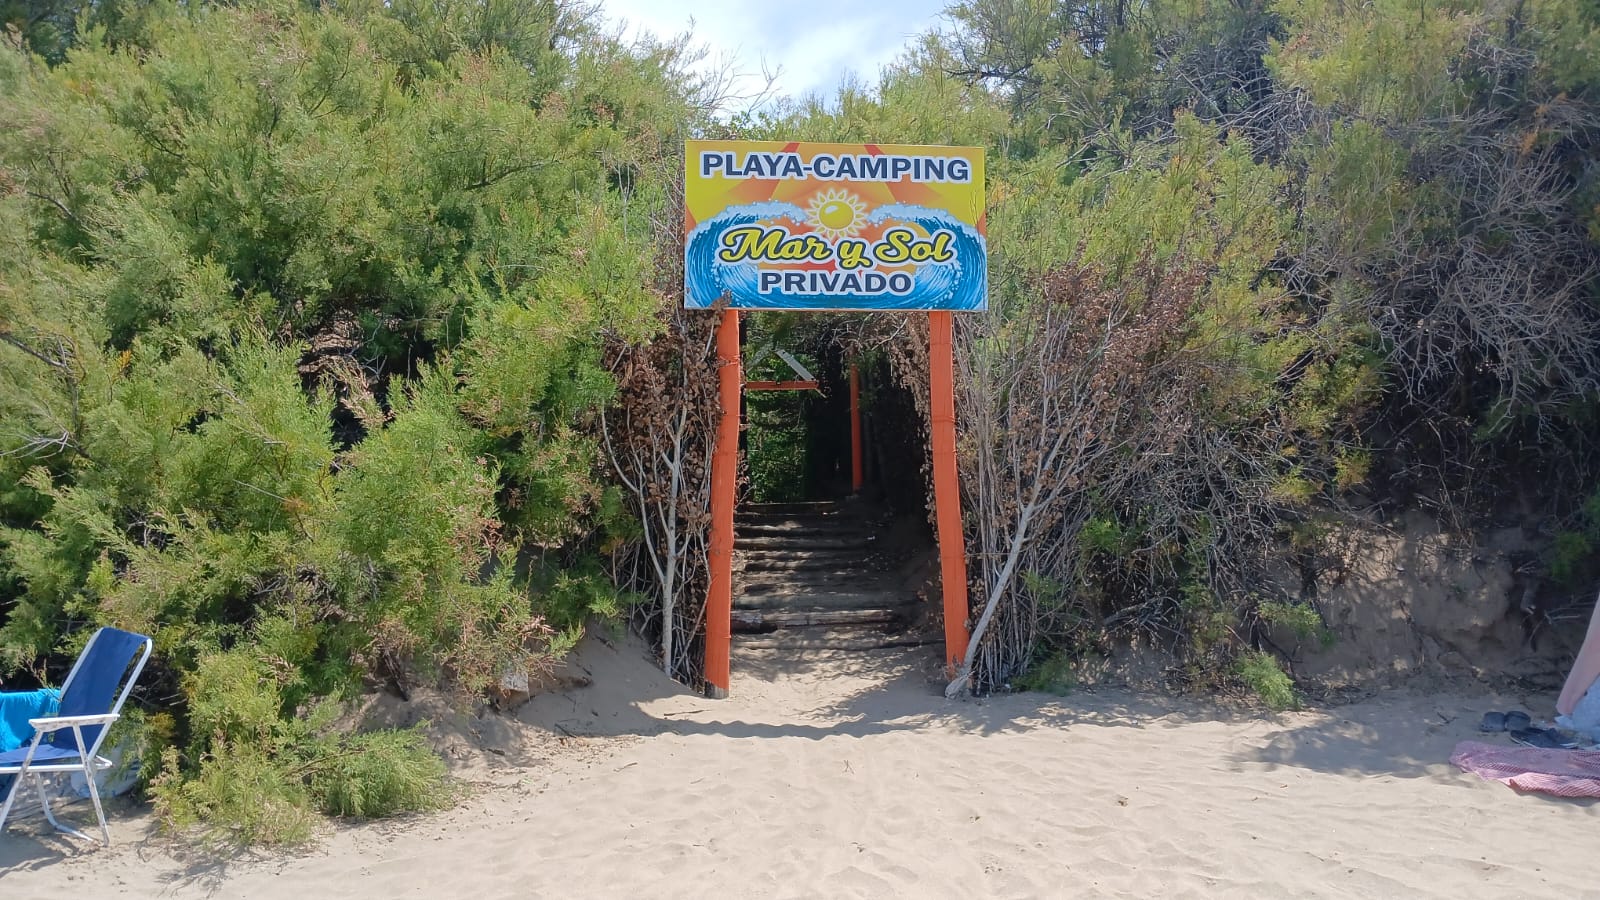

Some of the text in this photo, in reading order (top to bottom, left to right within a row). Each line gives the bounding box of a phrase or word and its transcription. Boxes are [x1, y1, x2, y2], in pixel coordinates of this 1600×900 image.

[703, 153, 969, 181] PLAYA-CAMPING
[719, 227, 954, 269] Mar y Sol
[761, 272, 912, 293] PRIVADO
